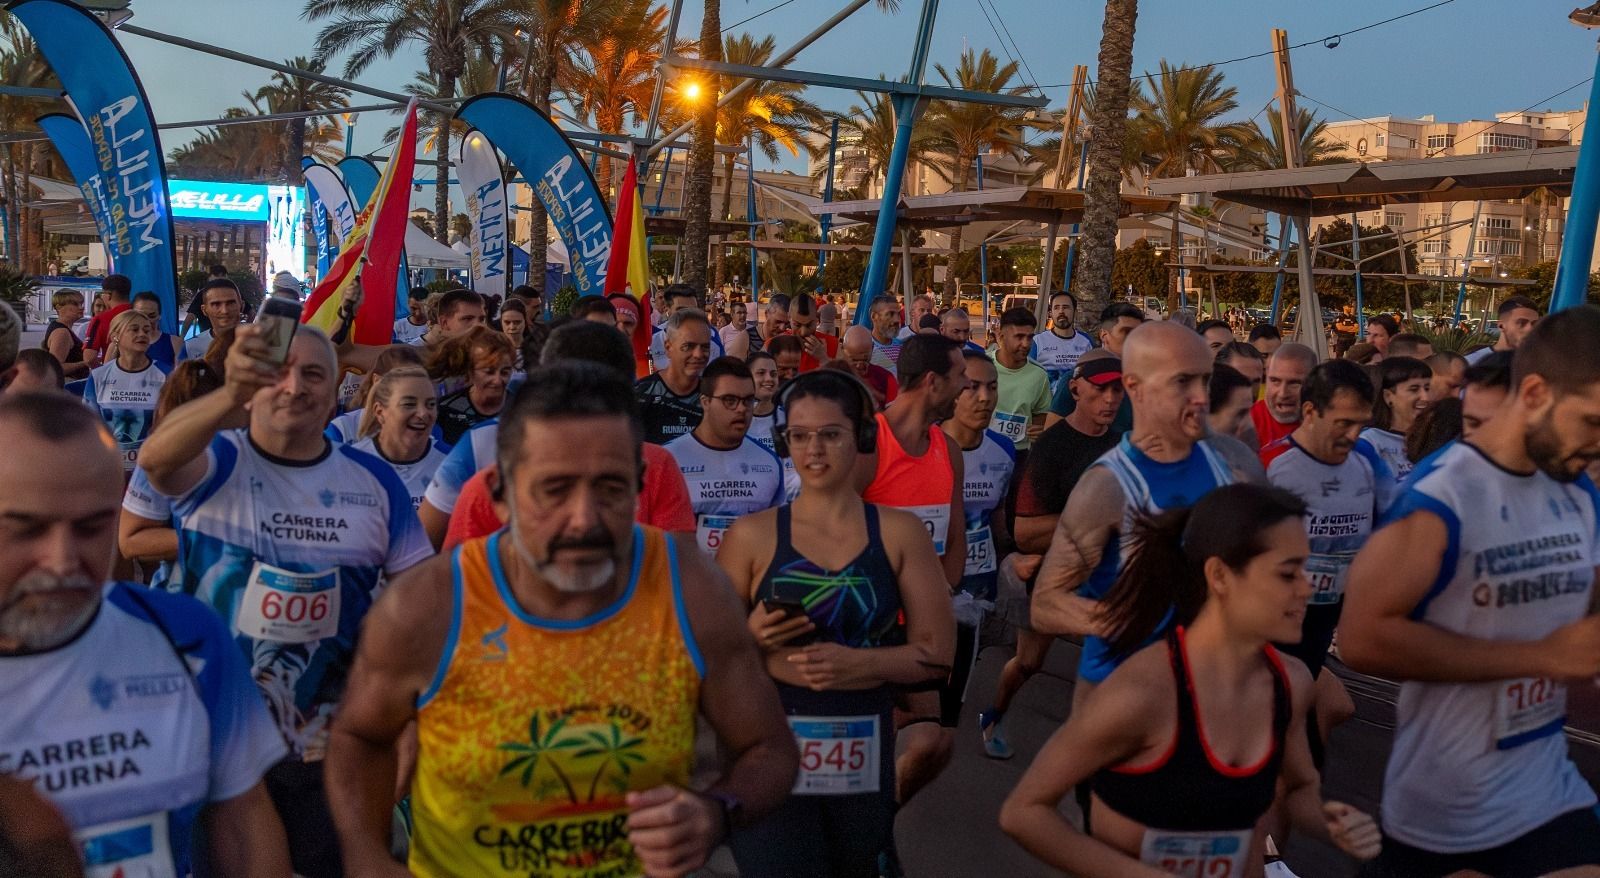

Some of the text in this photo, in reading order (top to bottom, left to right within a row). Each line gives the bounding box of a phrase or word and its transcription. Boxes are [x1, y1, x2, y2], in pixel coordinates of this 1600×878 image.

[998, 421, 1021, 435] 196
[700, 481, 758, 490] VI CARRERA
[700, 490, 753, 498] NOCTURNA
[272, 512, 348, 529] CARRERA
[261, 591, 328, 622] 606
[800, 740, 865, 772] 545
